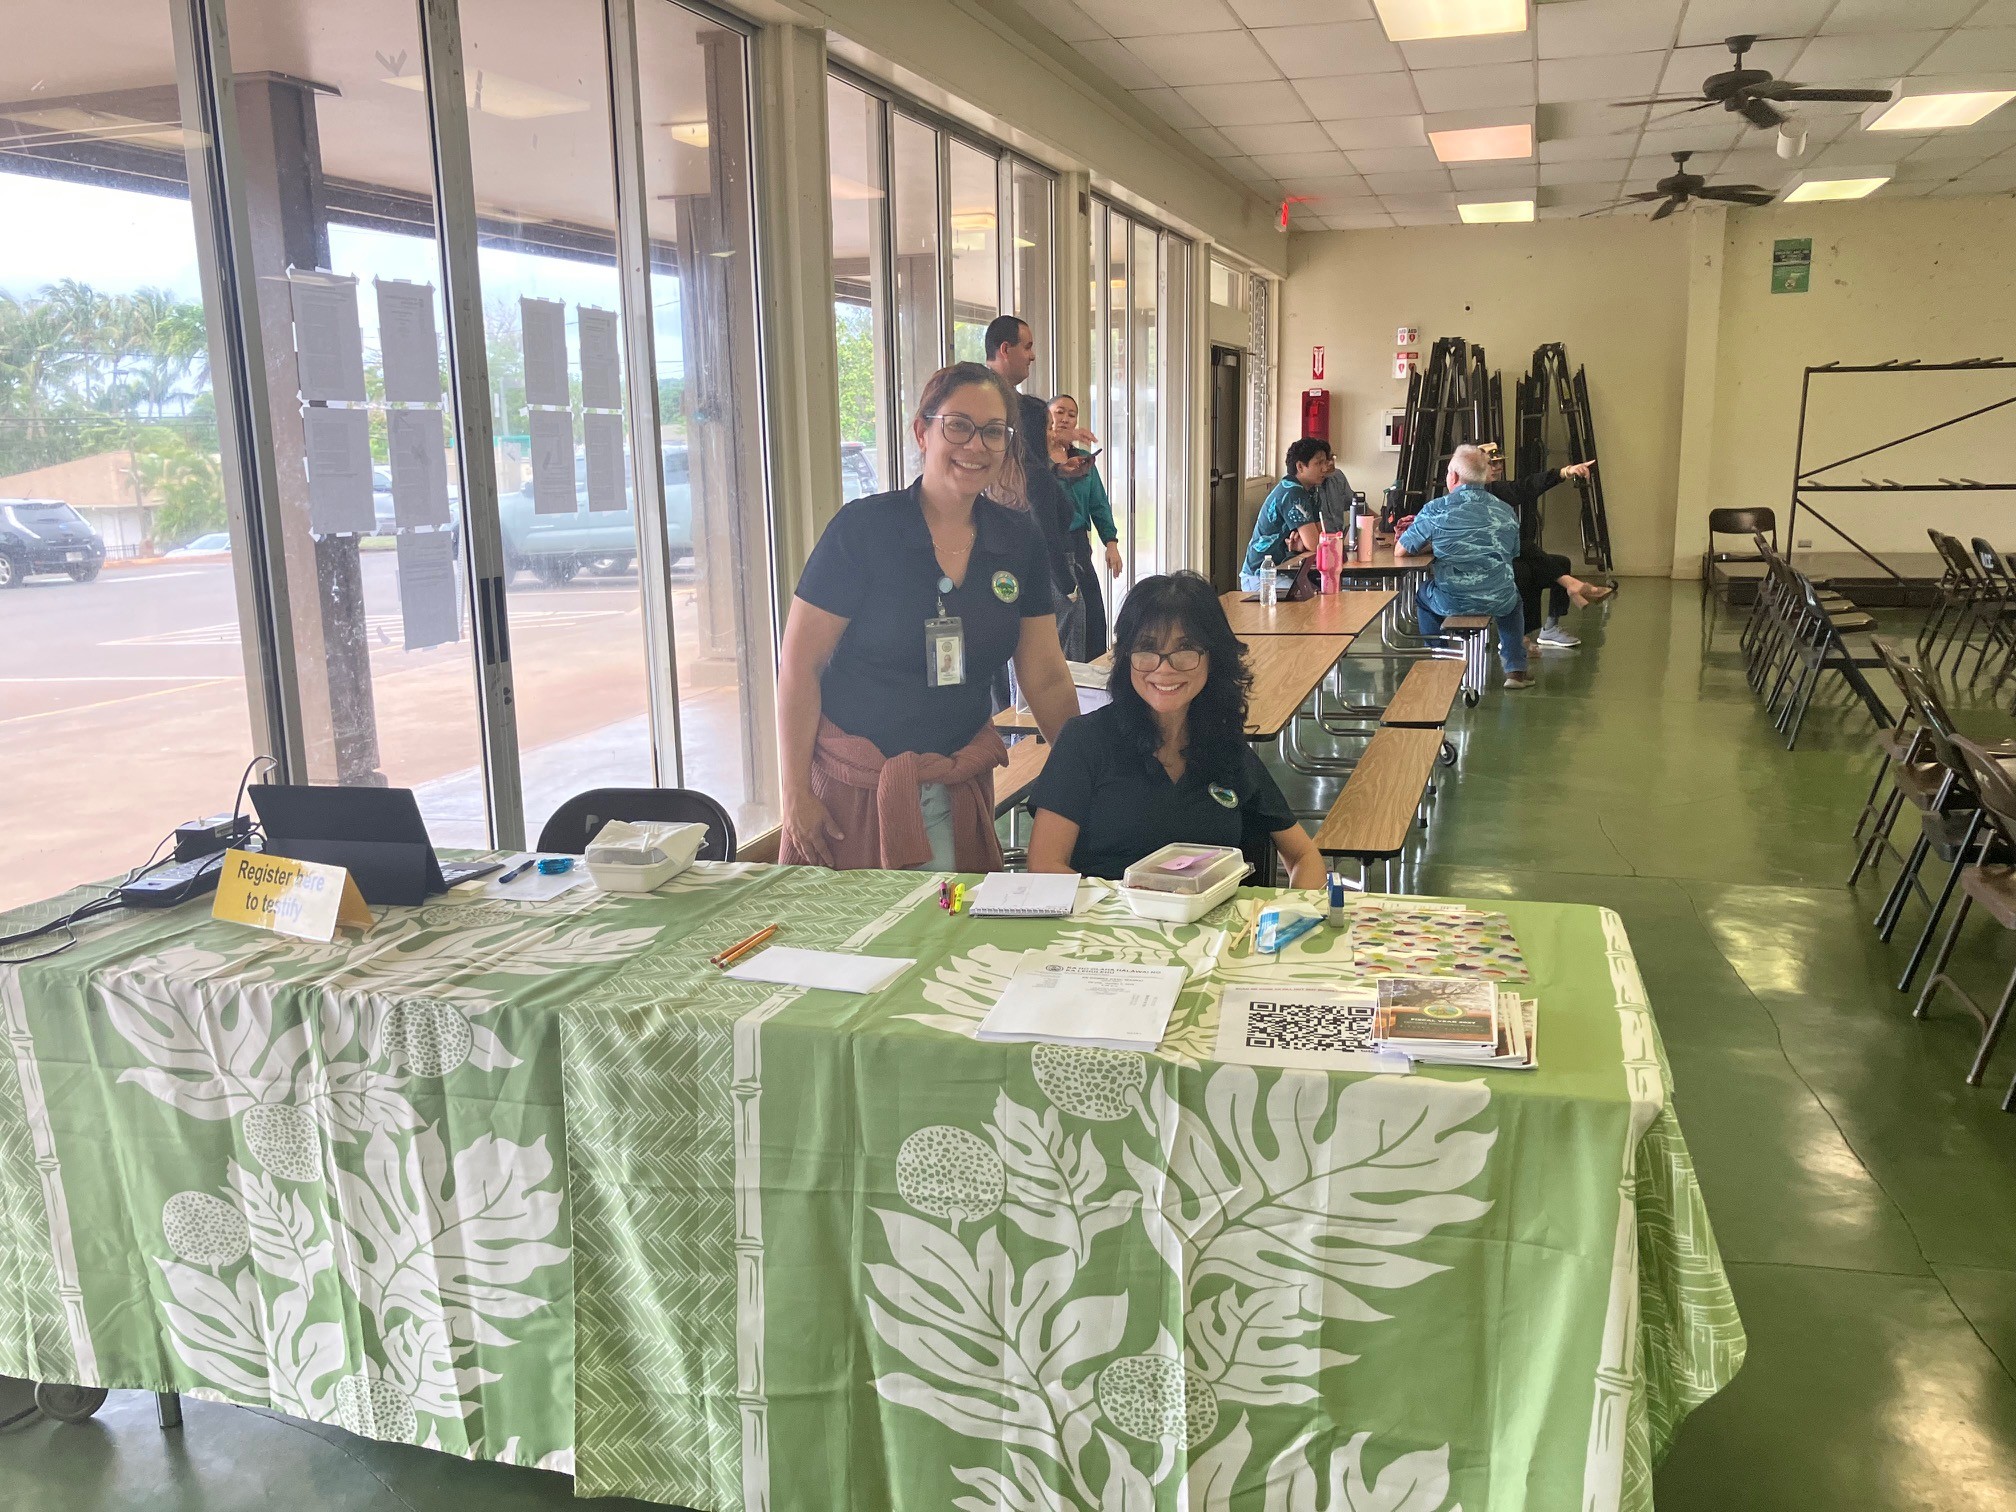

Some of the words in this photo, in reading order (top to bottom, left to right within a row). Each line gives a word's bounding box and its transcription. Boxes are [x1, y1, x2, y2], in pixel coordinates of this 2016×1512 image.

[237, 859, 294, 887] Register
[295, 868, 326, 892] here
[245, 891, 259, 911] to
[261, 894, 303, 923] testify
